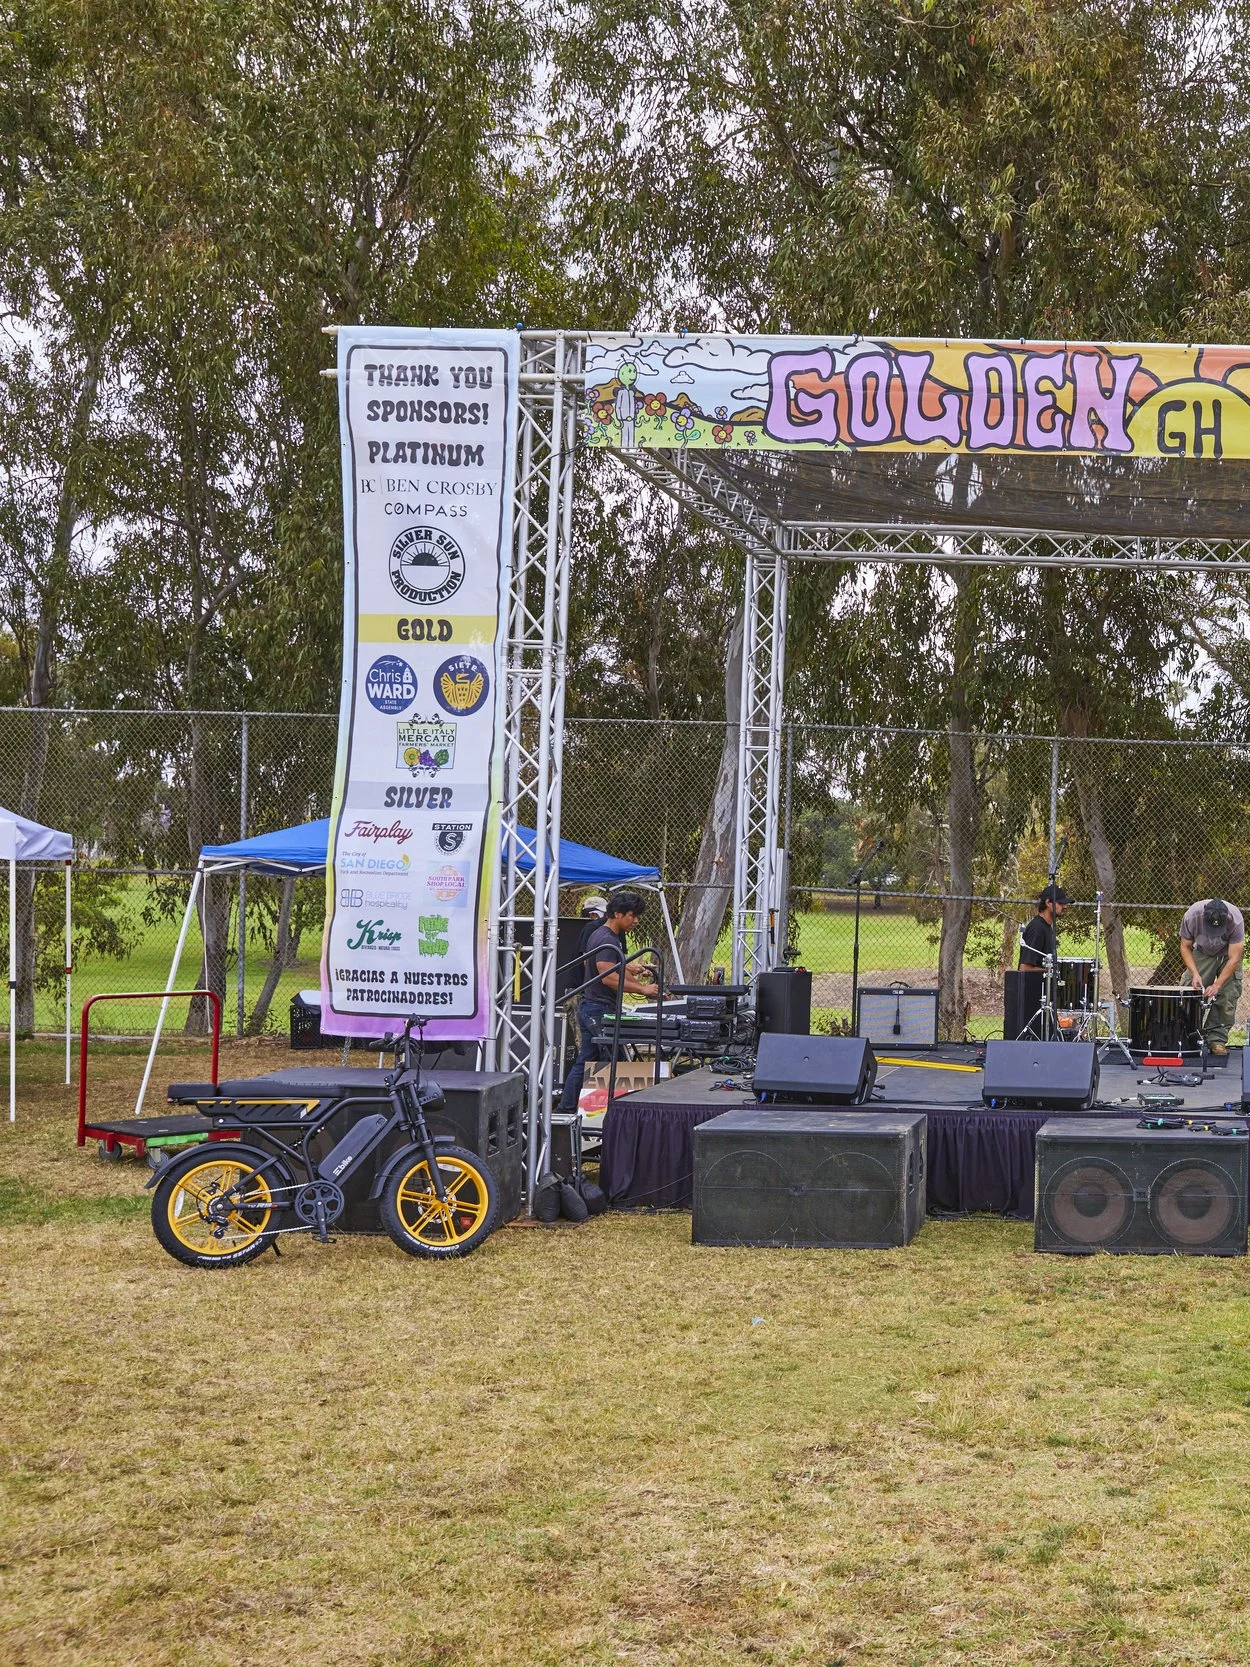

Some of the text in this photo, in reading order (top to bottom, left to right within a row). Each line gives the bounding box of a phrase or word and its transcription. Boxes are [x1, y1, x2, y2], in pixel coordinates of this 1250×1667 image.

[364, 364, 493, 389] THANK YOU
[763, 347, 1142, 453] GOLDEN
[366, 399, 489, 425] SPONSORS!
[1157, 399, 1223, 458] GH
[368, 440, 485, 466] PLATINUM
[387, 478, 420, 493] BEN
[426, 480, 498, 496] CROSBY
[384, 502, 468, 518] COMPASS
[392, 529, 460, 561] SILVER SUN
[391, 569, 462, 602] PRODUCTION
[397, 618, 453, 642] GOLD
[369, 668, 402, 683] Chris
[448, 661, 478, 673] SIETE
[367, 683, 416, 699] WARD
[398, 734, 455, 743] MERCATO
[384, 785, 453, 809] SILVER
[344, 819, 413, 845] Fairplay
[433, 823, 471, 831] STATION
[340, 858, 406, 870] SAN DIEGO
[390, 970, 399, 984] A
[403, 971, 468, 987] NUESTROS
[346, 987, 454, 1005] PATROCINADORES!
